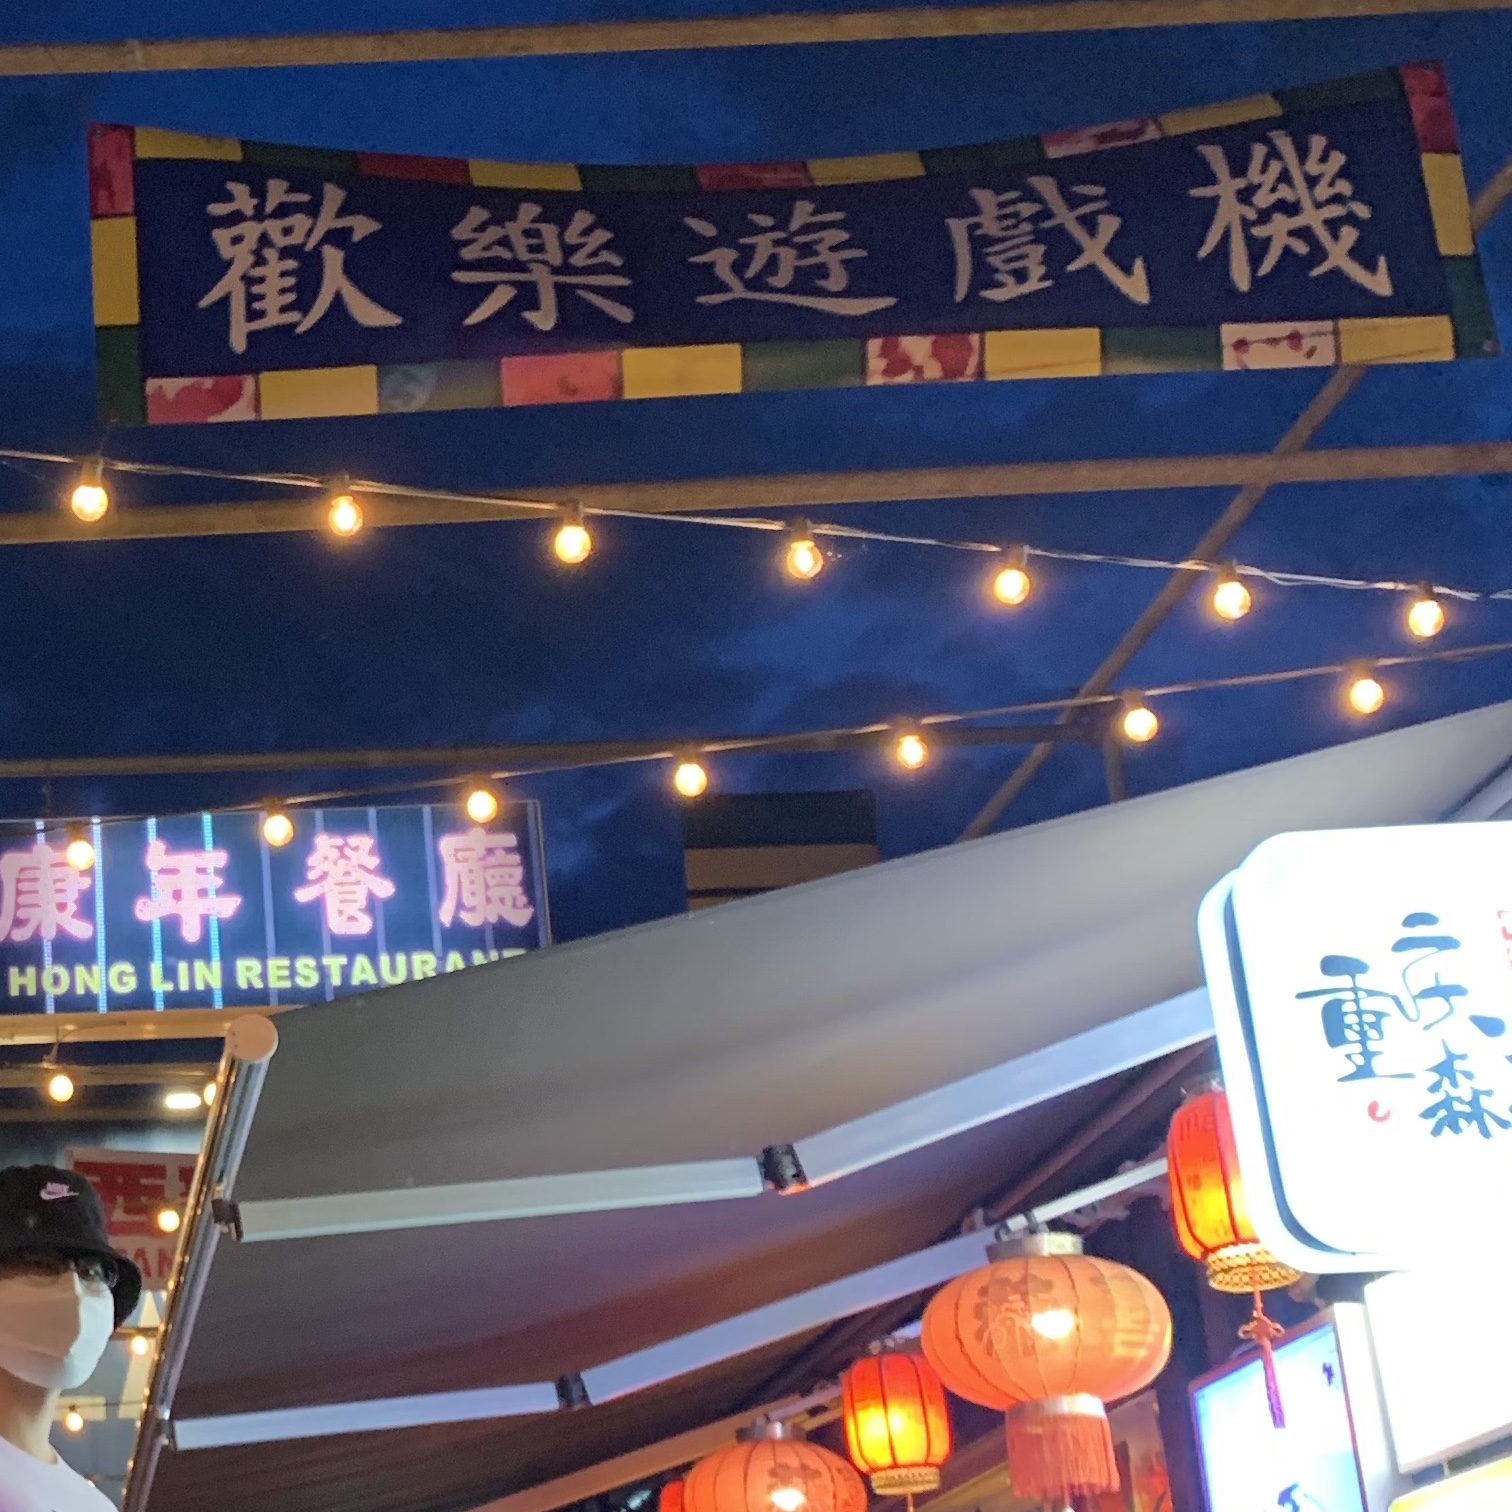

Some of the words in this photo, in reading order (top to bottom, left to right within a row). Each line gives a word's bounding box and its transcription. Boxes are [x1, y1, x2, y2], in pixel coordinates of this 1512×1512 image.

[7, 960, 137, 997] HONG
[149, 958, 222, 992] LIN
[235, 946, 528, 989] RESTAURA
